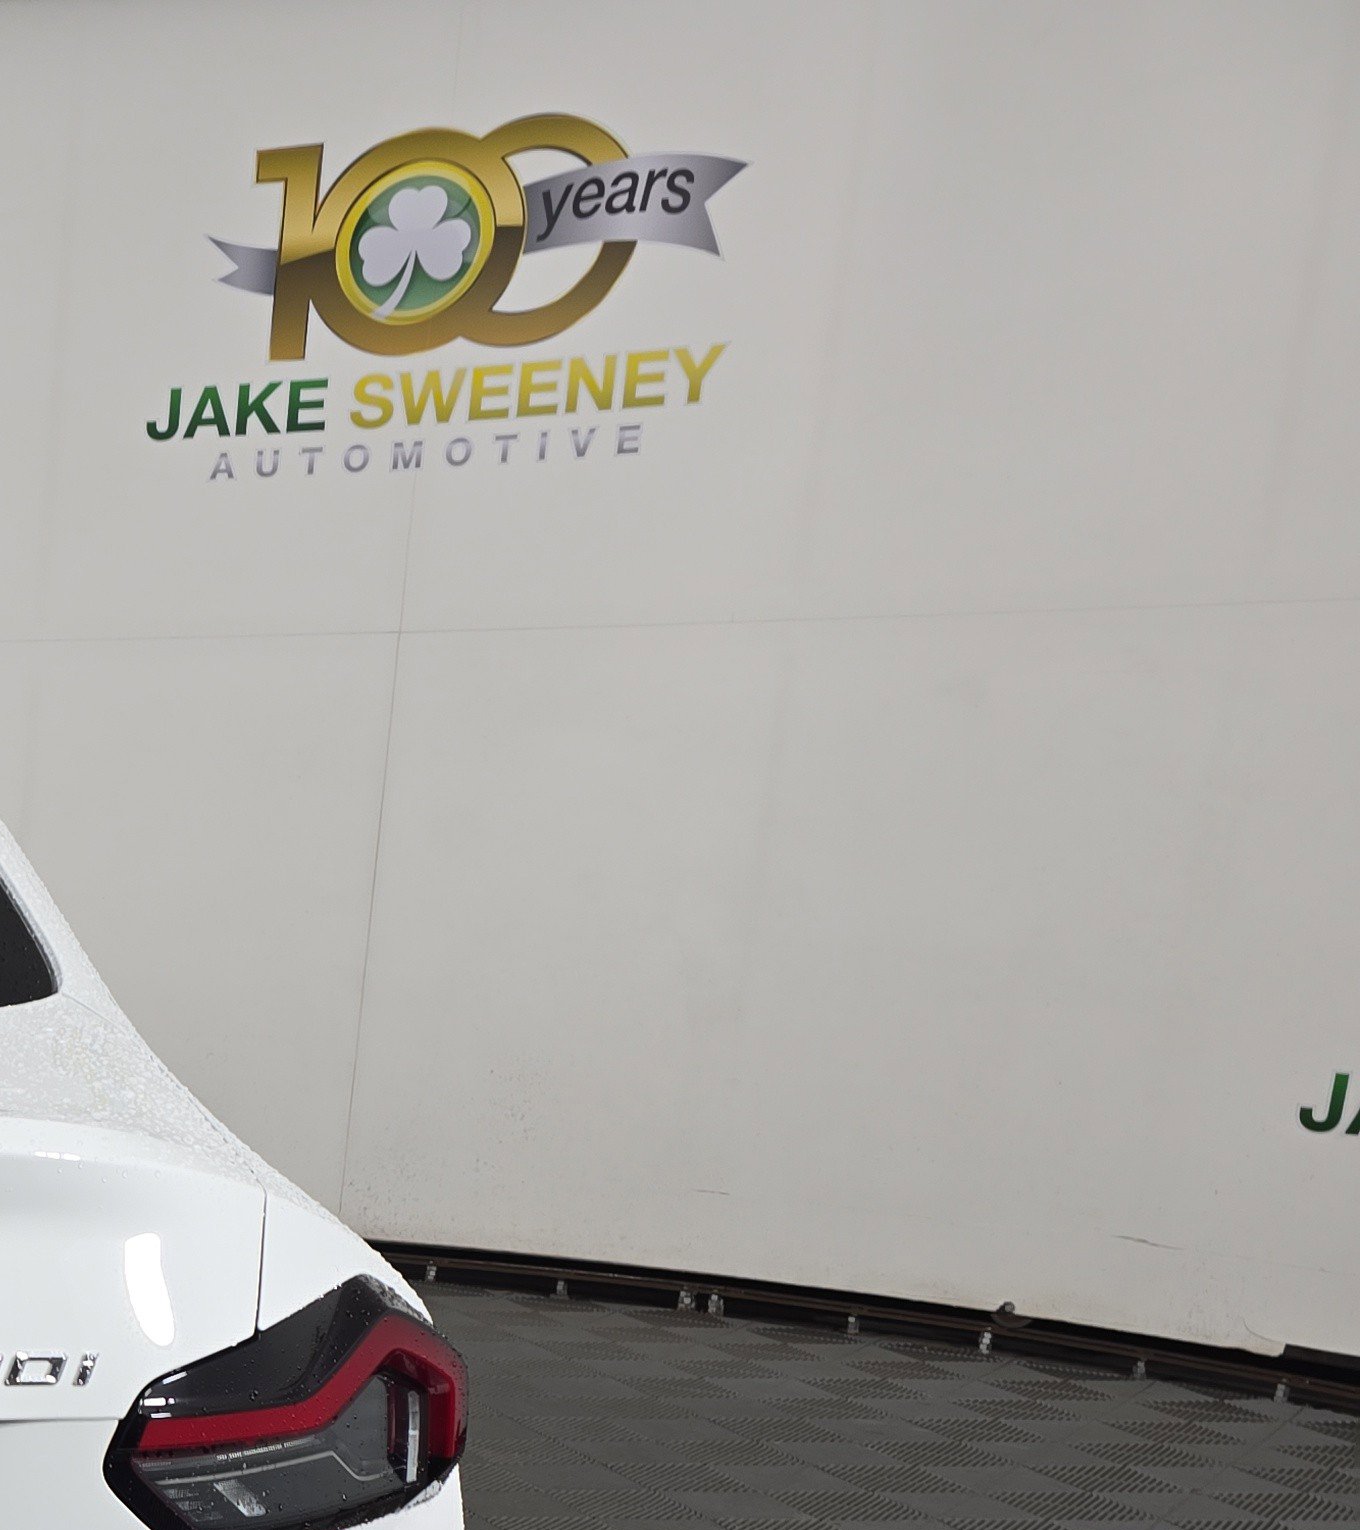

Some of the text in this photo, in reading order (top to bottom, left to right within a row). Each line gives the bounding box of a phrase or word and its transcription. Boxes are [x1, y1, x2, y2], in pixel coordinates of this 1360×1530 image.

[256, 112, 695, 361] 100 years
[146, 344, 727, 442] JAKE SWEENEY
[209, 424, 642, 482] AUTOMOTIVE
